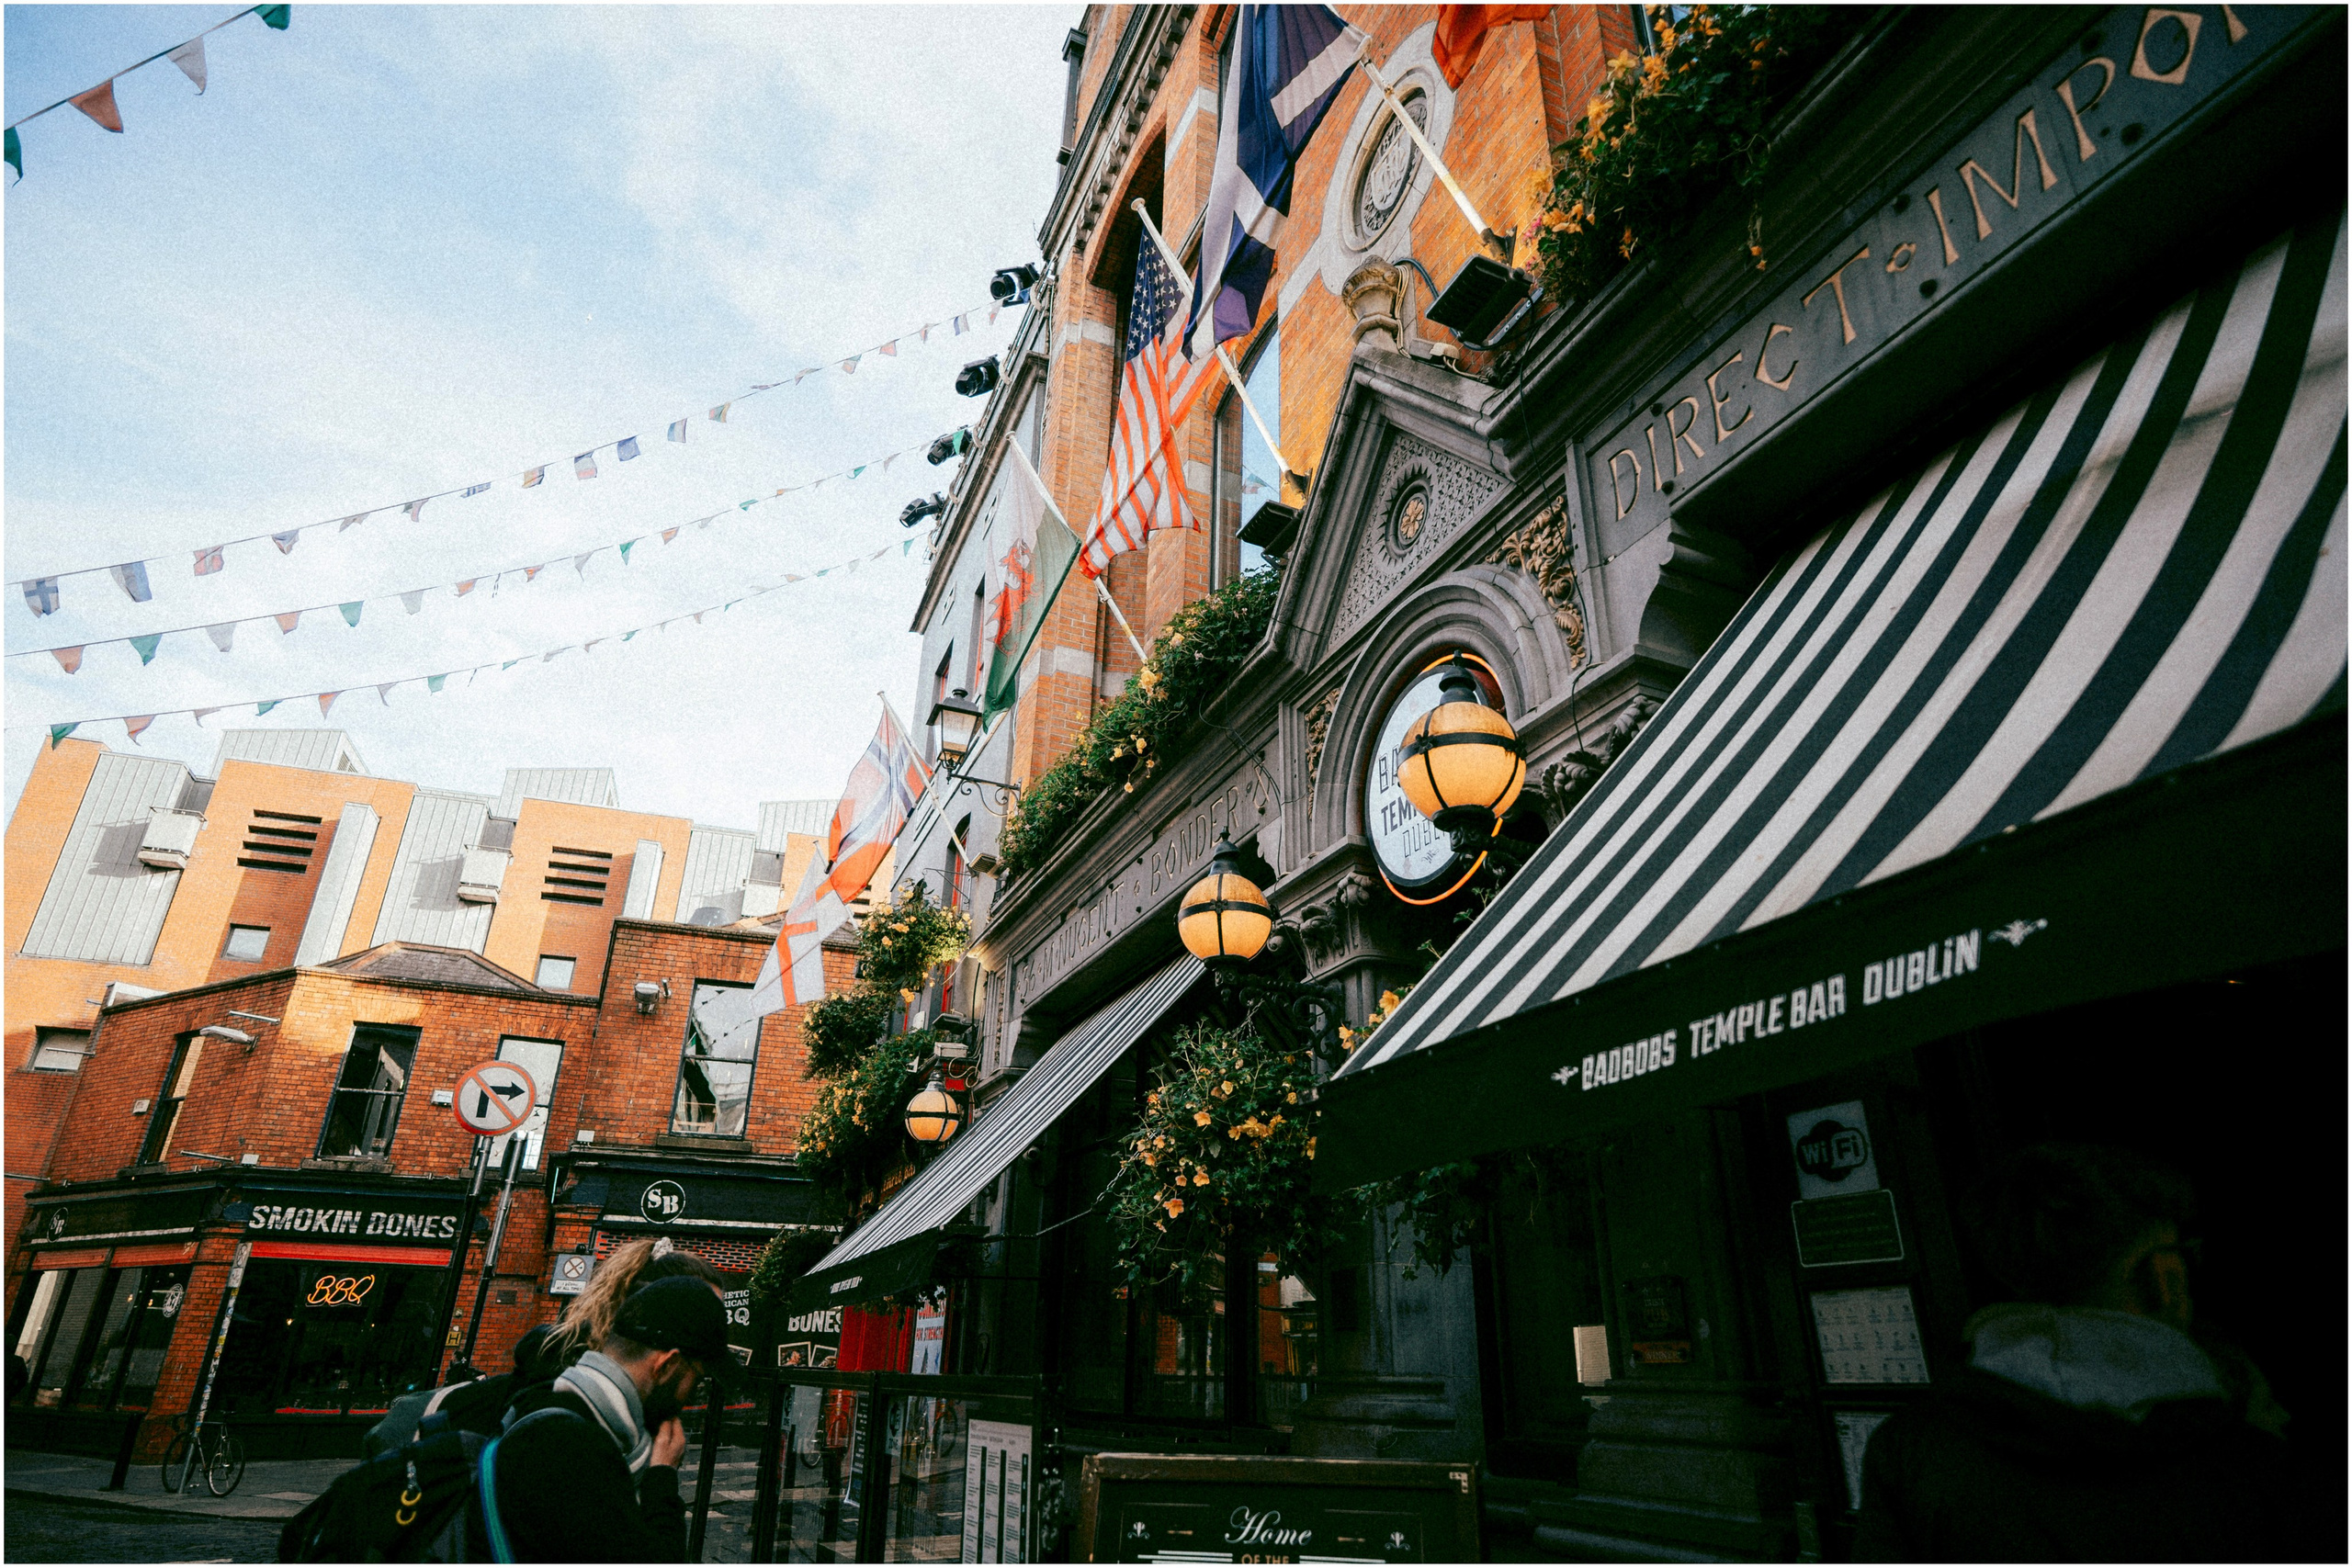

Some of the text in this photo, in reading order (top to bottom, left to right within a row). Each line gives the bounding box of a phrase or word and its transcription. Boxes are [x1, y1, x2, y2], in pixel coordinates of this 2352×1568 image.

[1608, 4, 2248, 522] DIRECT IMPO
[1381, 796, 1417, 836] TEM
[1150, 785, 1239, 897] BONDER
[1581, 1028, 1678, 1091] BADBOBS
[1689, 994, 1785, 1059] TEMPLE
[1790, 972, 1847, 1030] BAR
[248, 1204, 458, 1238] SMOKIN BONES
[647, 1188, 679, 1214] SB
[307, 1274, 375, 1304] BBQ
[448, 1333, 459, 1345] H
[1225, 1506, 1312, 1546] Home
